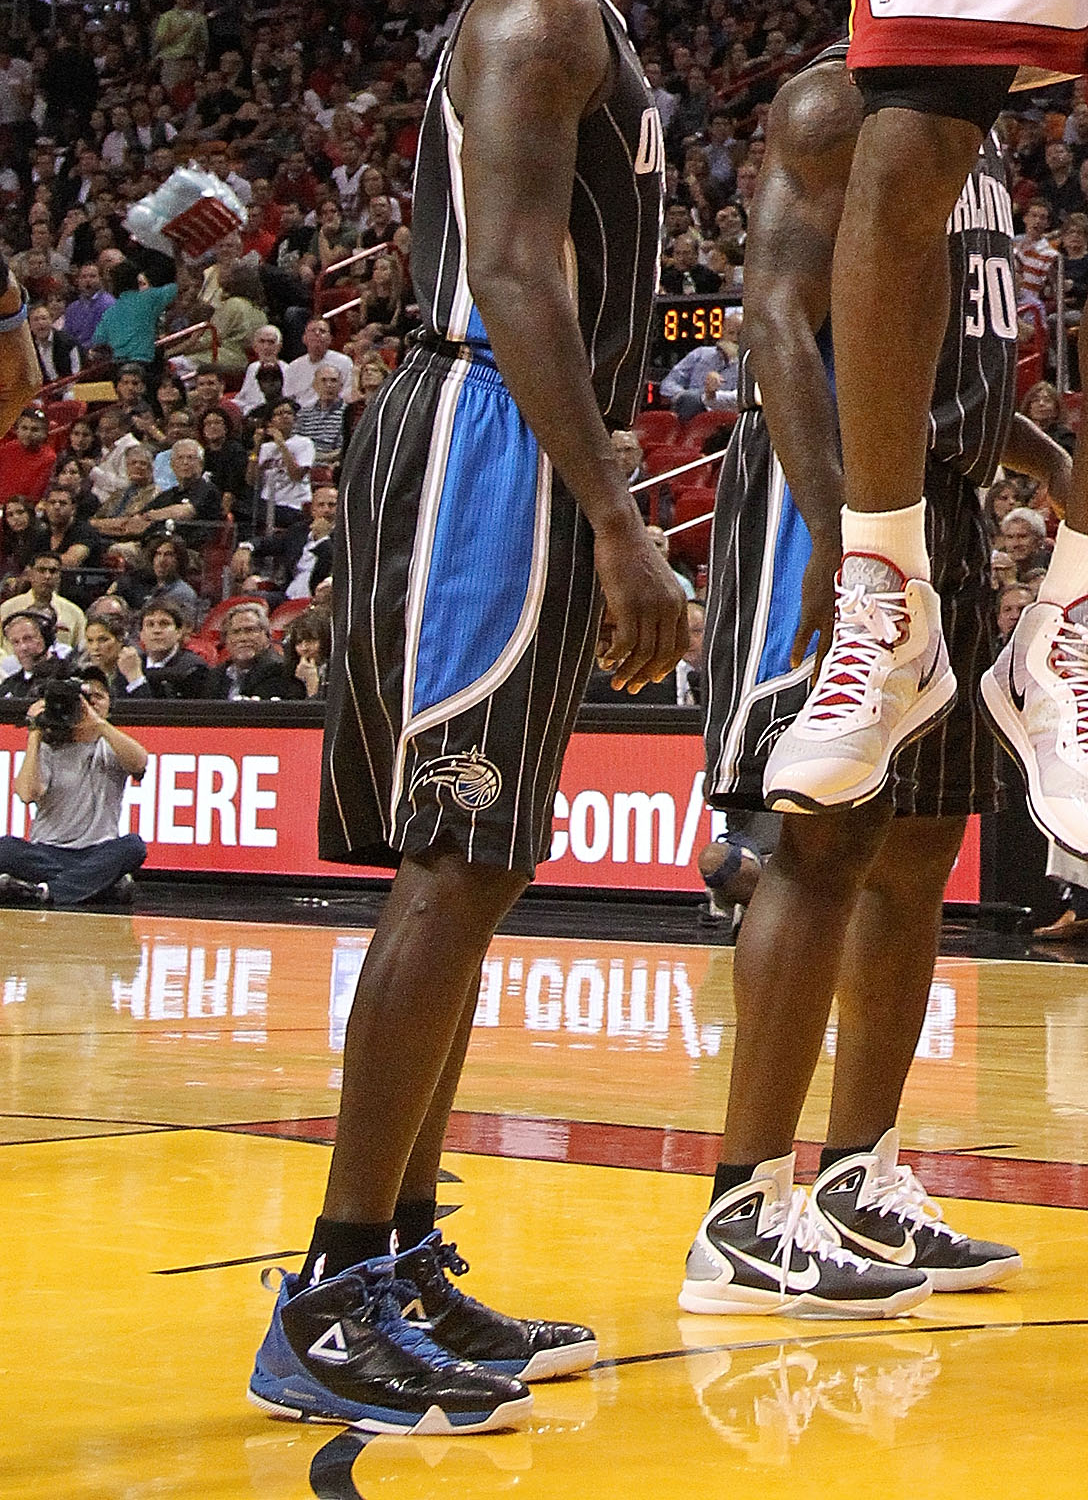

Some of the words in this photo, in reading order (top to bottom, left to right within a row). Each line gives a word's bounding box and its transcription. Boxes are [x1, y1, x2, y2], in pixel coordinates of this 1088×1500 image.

[664, 308, 724, 341] 8:58
[964, 253, 1019, 340] 30
[117, 752, 280, 848] HERE
